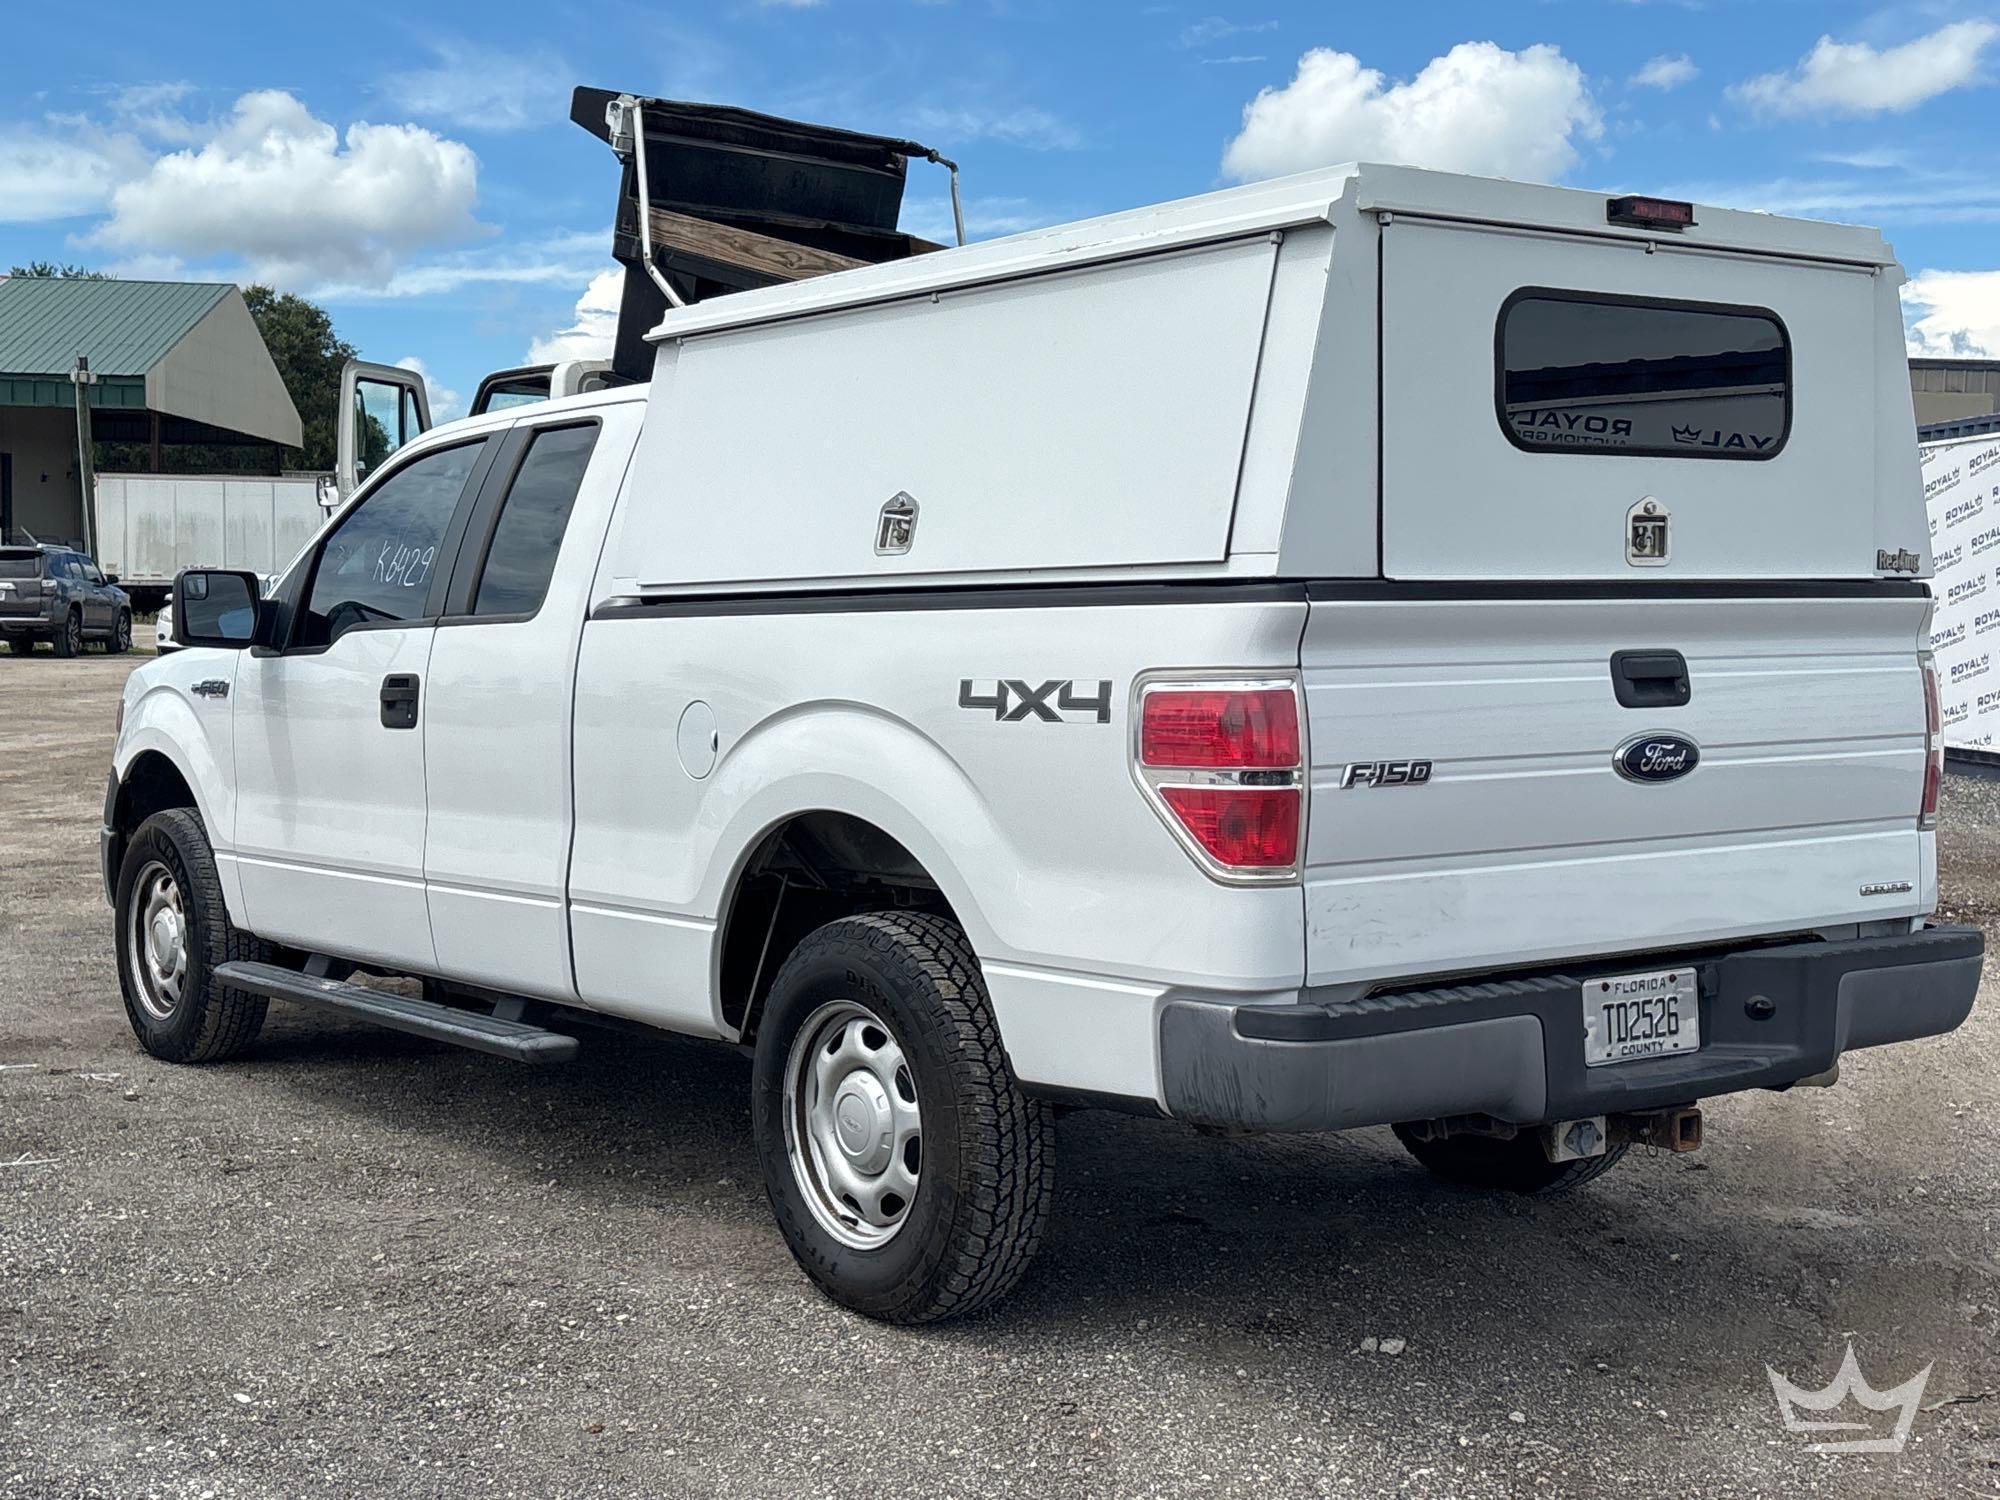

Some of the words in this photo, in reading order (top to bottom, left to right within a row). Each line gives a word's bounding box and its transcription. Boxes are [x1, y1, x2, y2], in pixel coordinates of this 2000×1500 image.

[1970, 446, 1999, 470] ROYAL
[1925, 472, 1953, 494] ROYAL
[1946, 500, 1975, 521] ROYAL
[1933, 550, 1954, 567] OYAL
[1948, 578, 1978, 599] ROYAL
[1975, 609, 2000, 627] ROYA
[1951, 657, 1981, 677] ROYAL
[1978, 690, 2000, 707] ROYA
[1944, 705, 1960, 718] YAL
[1640, 743, 1687, 771] Ford
[1340, 760, 1433, 789] F-150
[1615, 977, 1666, 994] FLORIDA
[1602, 996, 1679, 1045] TD2526
[1621, 1040, 1665, 1056] COUNTY
